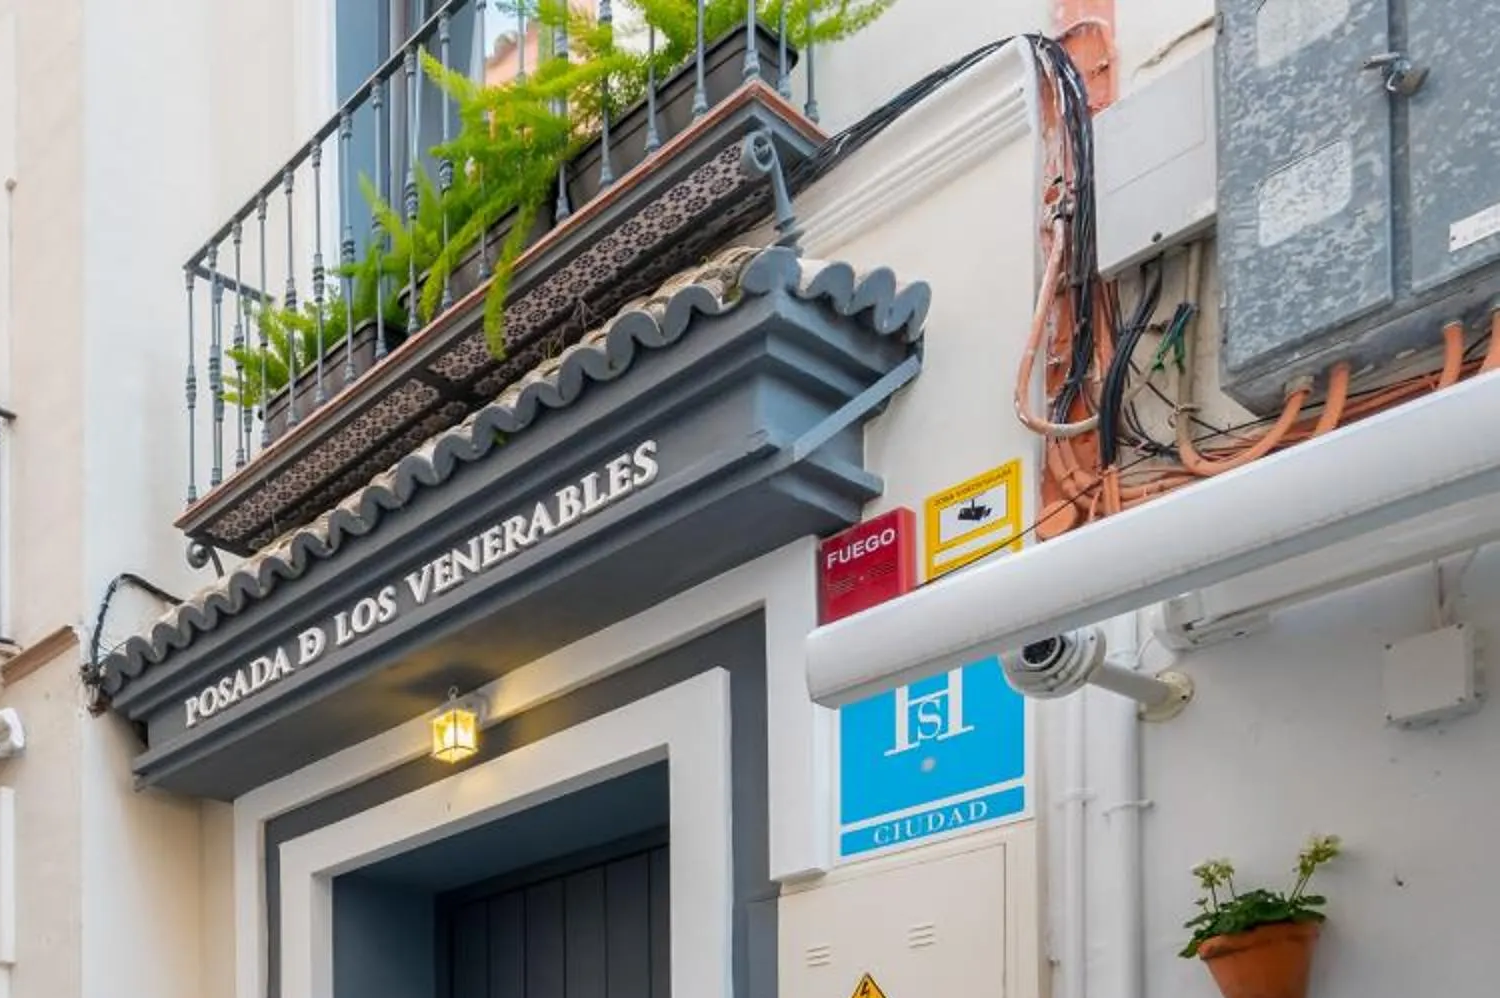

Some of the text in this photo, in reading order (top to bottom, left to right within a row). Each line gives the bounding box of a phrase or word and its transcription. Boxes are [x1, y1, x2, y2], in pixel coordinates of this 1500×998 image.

[827, 528, 895, 570] FUEGO
[184, 645, 292, 729] POSADA
[334, 585, 398, 647] LOS
[404, 440, 659, 604] VENERABLES
[873, 800, 988, 844] CIUDAD
